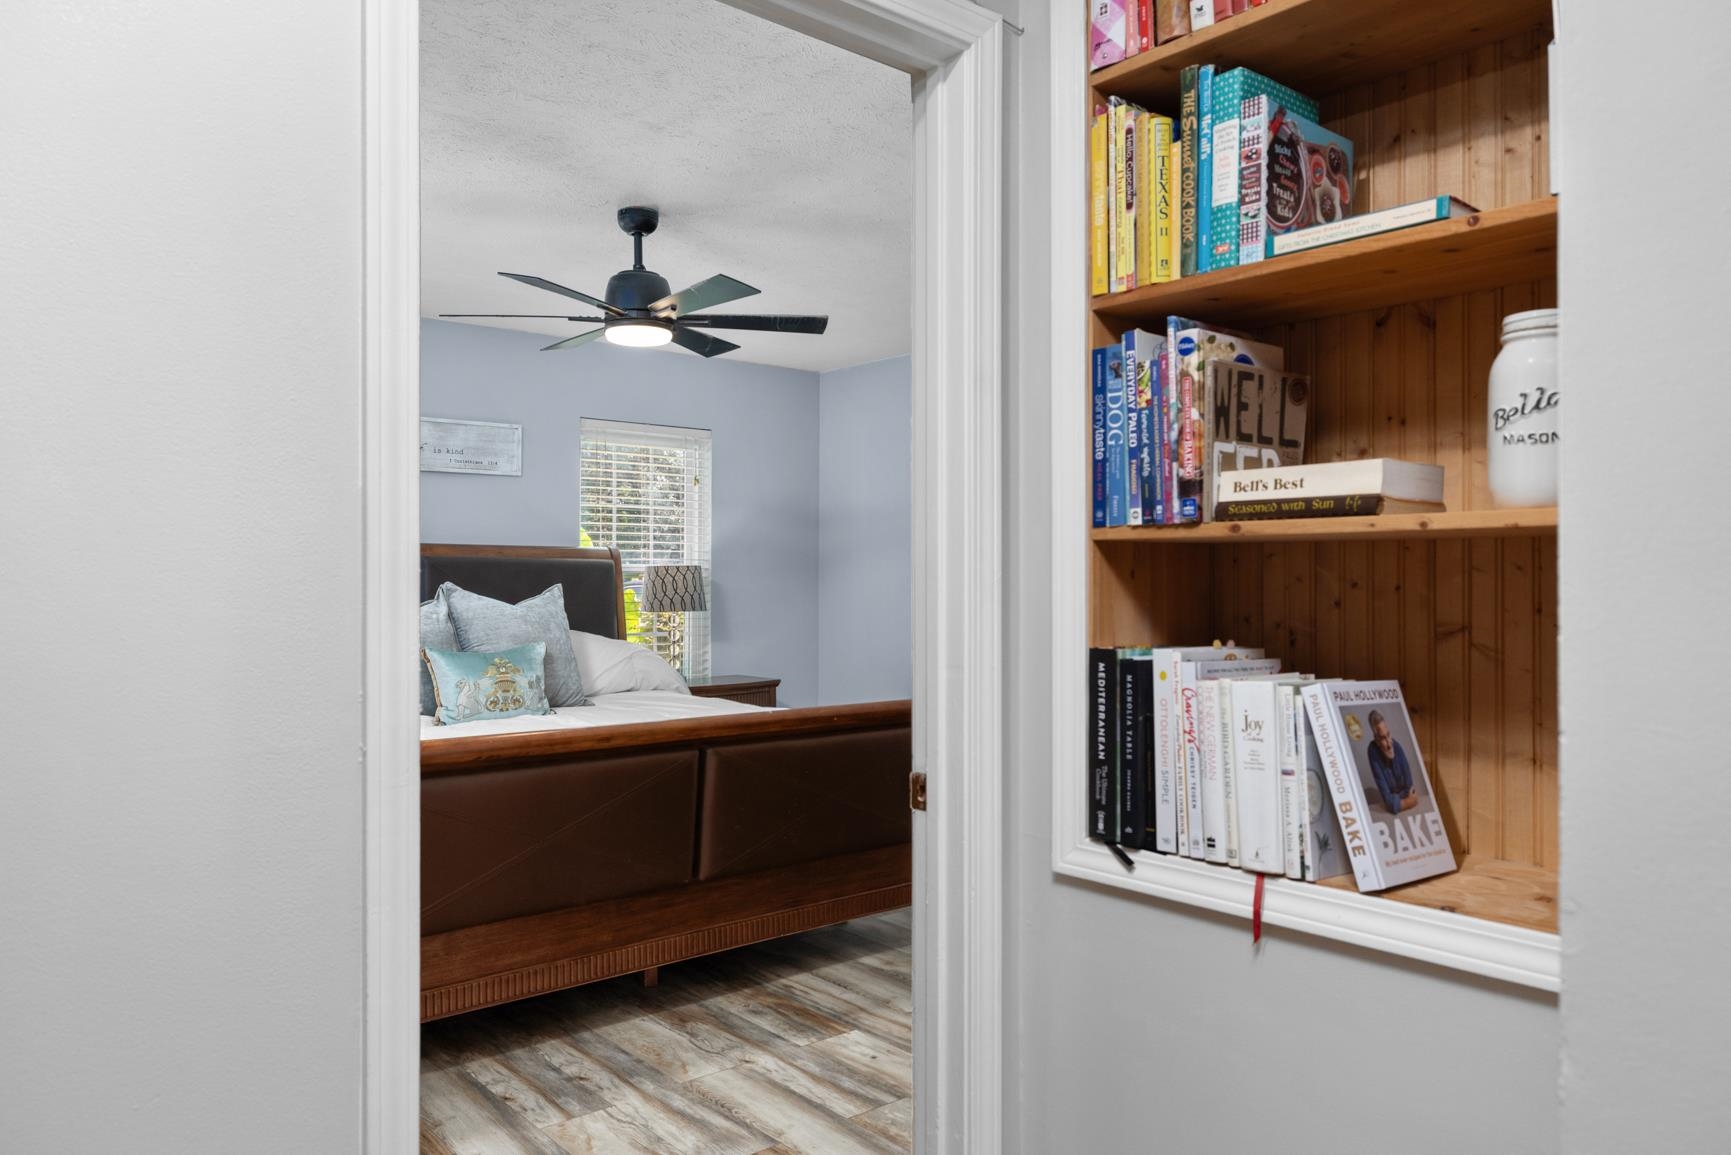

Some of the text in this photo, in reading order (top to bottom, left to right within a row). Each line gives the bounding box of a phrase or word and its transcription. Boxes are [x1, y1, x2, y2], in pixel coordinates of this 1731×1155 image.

[1157, 155, 1169, 220] TEXAS
[1182, 89, 1197, 243] THE Sunset COOK BOOK
[1126, 350, 1136, 408] EVERYDAY
[1094, 393, 1106, 460] skinnytaste
[1107, 390, 1124, 446] DOG
[1213, 367, 1299, 448] WELL
[1494, 387, 1560, 431] Bella
[446, 447, 464, 455] kind
[1128, 412, 1137, 448] PALEO
[1503, 431, 1560, 446] MASON
[1183, 441, 1194, 477] BAKING
[1227, 498, 1335, 515] Seasoned with Sun
[1233, 478, 1304, 493] Bell's Best
[1097, 662, 1106, 760] MEDITERRANEAN
[1333, 687, 1399, 702] PAUL HOLLYWOOD
[1206, 705, 1216, 731] NEW
[1126, 730, 1134, 760] TABLE
[1159, 698, 1170, 807] OTTOLENGHI SIMPLE
[1207, 734, 1217, 781] GERMAN
[1309, 693, 1367, 858] PAUL HOLLYWOOD BAKE
[1372, 811, 1446, 854] BAKE
